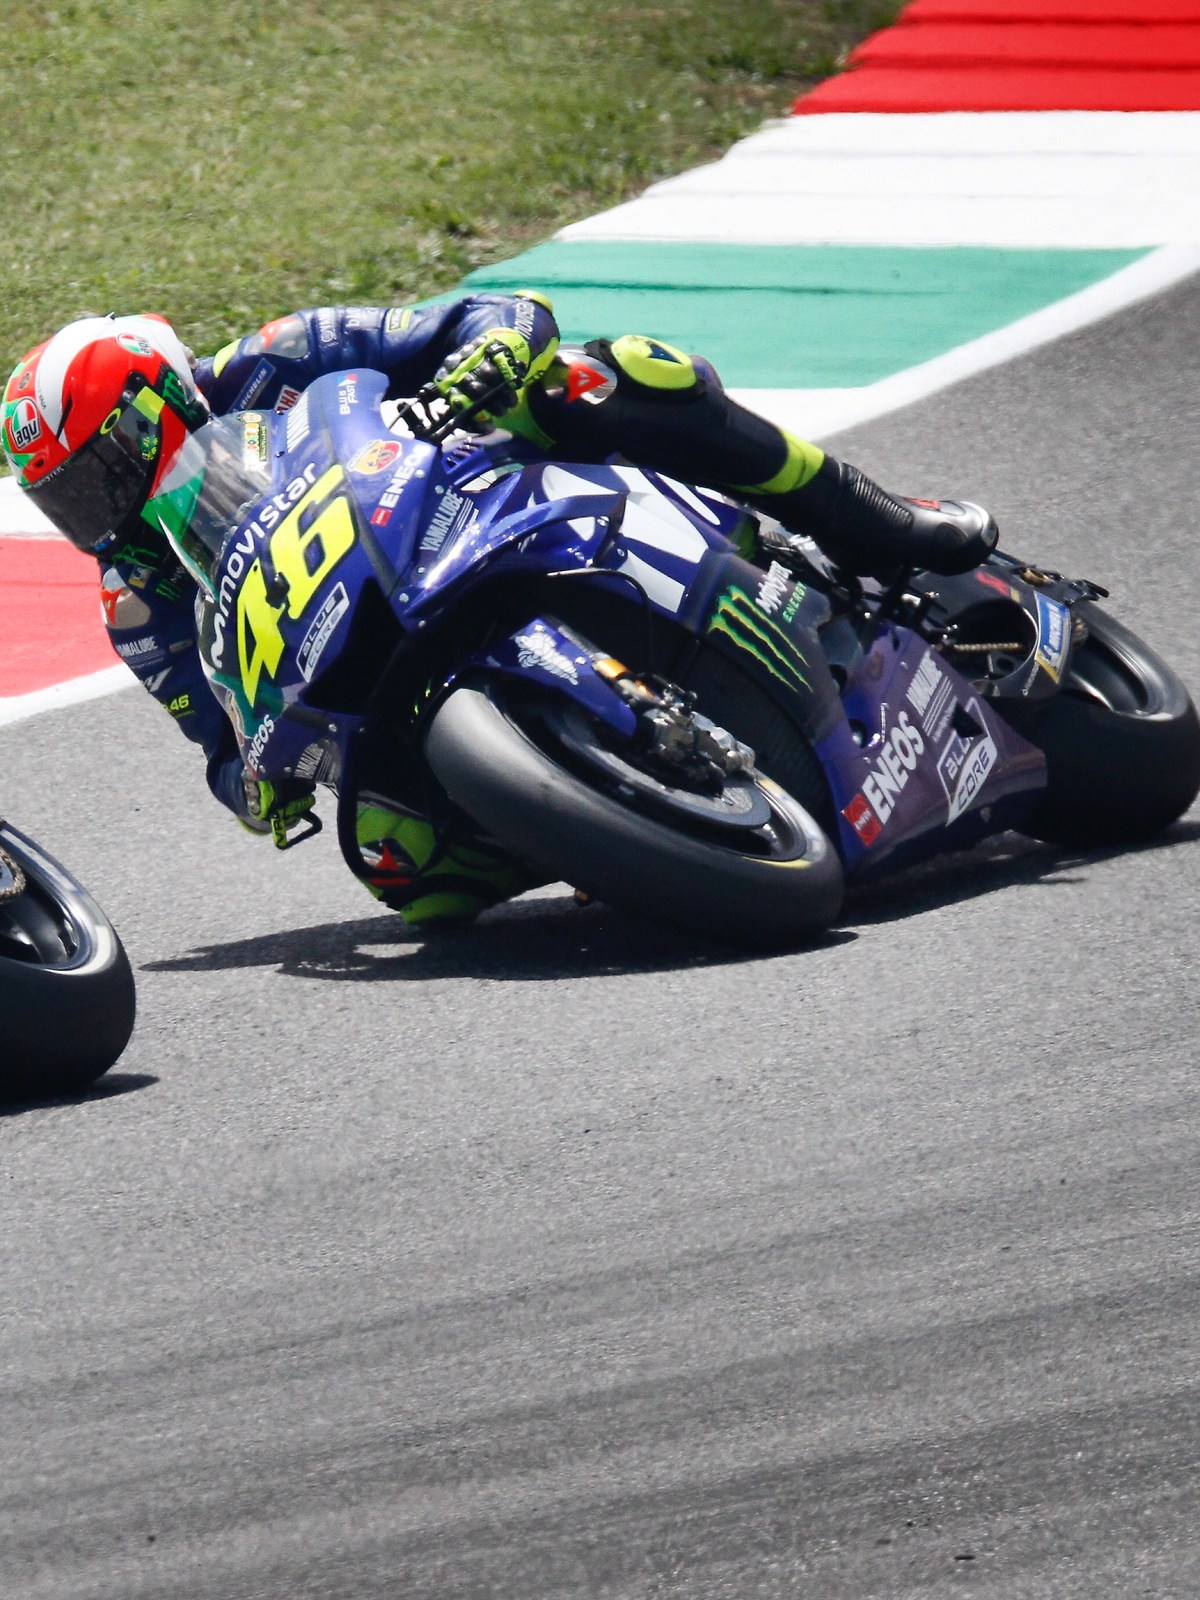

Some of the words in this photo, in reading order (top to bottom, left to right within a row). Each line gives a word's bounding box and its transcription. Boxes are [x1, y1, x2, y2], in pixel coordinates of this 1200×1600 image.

[240, 368, 267, 410] MICHELIN
[15, 419, 38, 445] agv
[419, 489, 465, 552] YAMALUBE
[210, 462, 317, 669] movistar
[236, 463, 358, 709] 46
[782, 580, 808, 624] ENERGY
[247, 714, 276, 772] ENEOS
[861, 710, 925, 825] ENEOS
[957, 743, 991, 810] CORE
